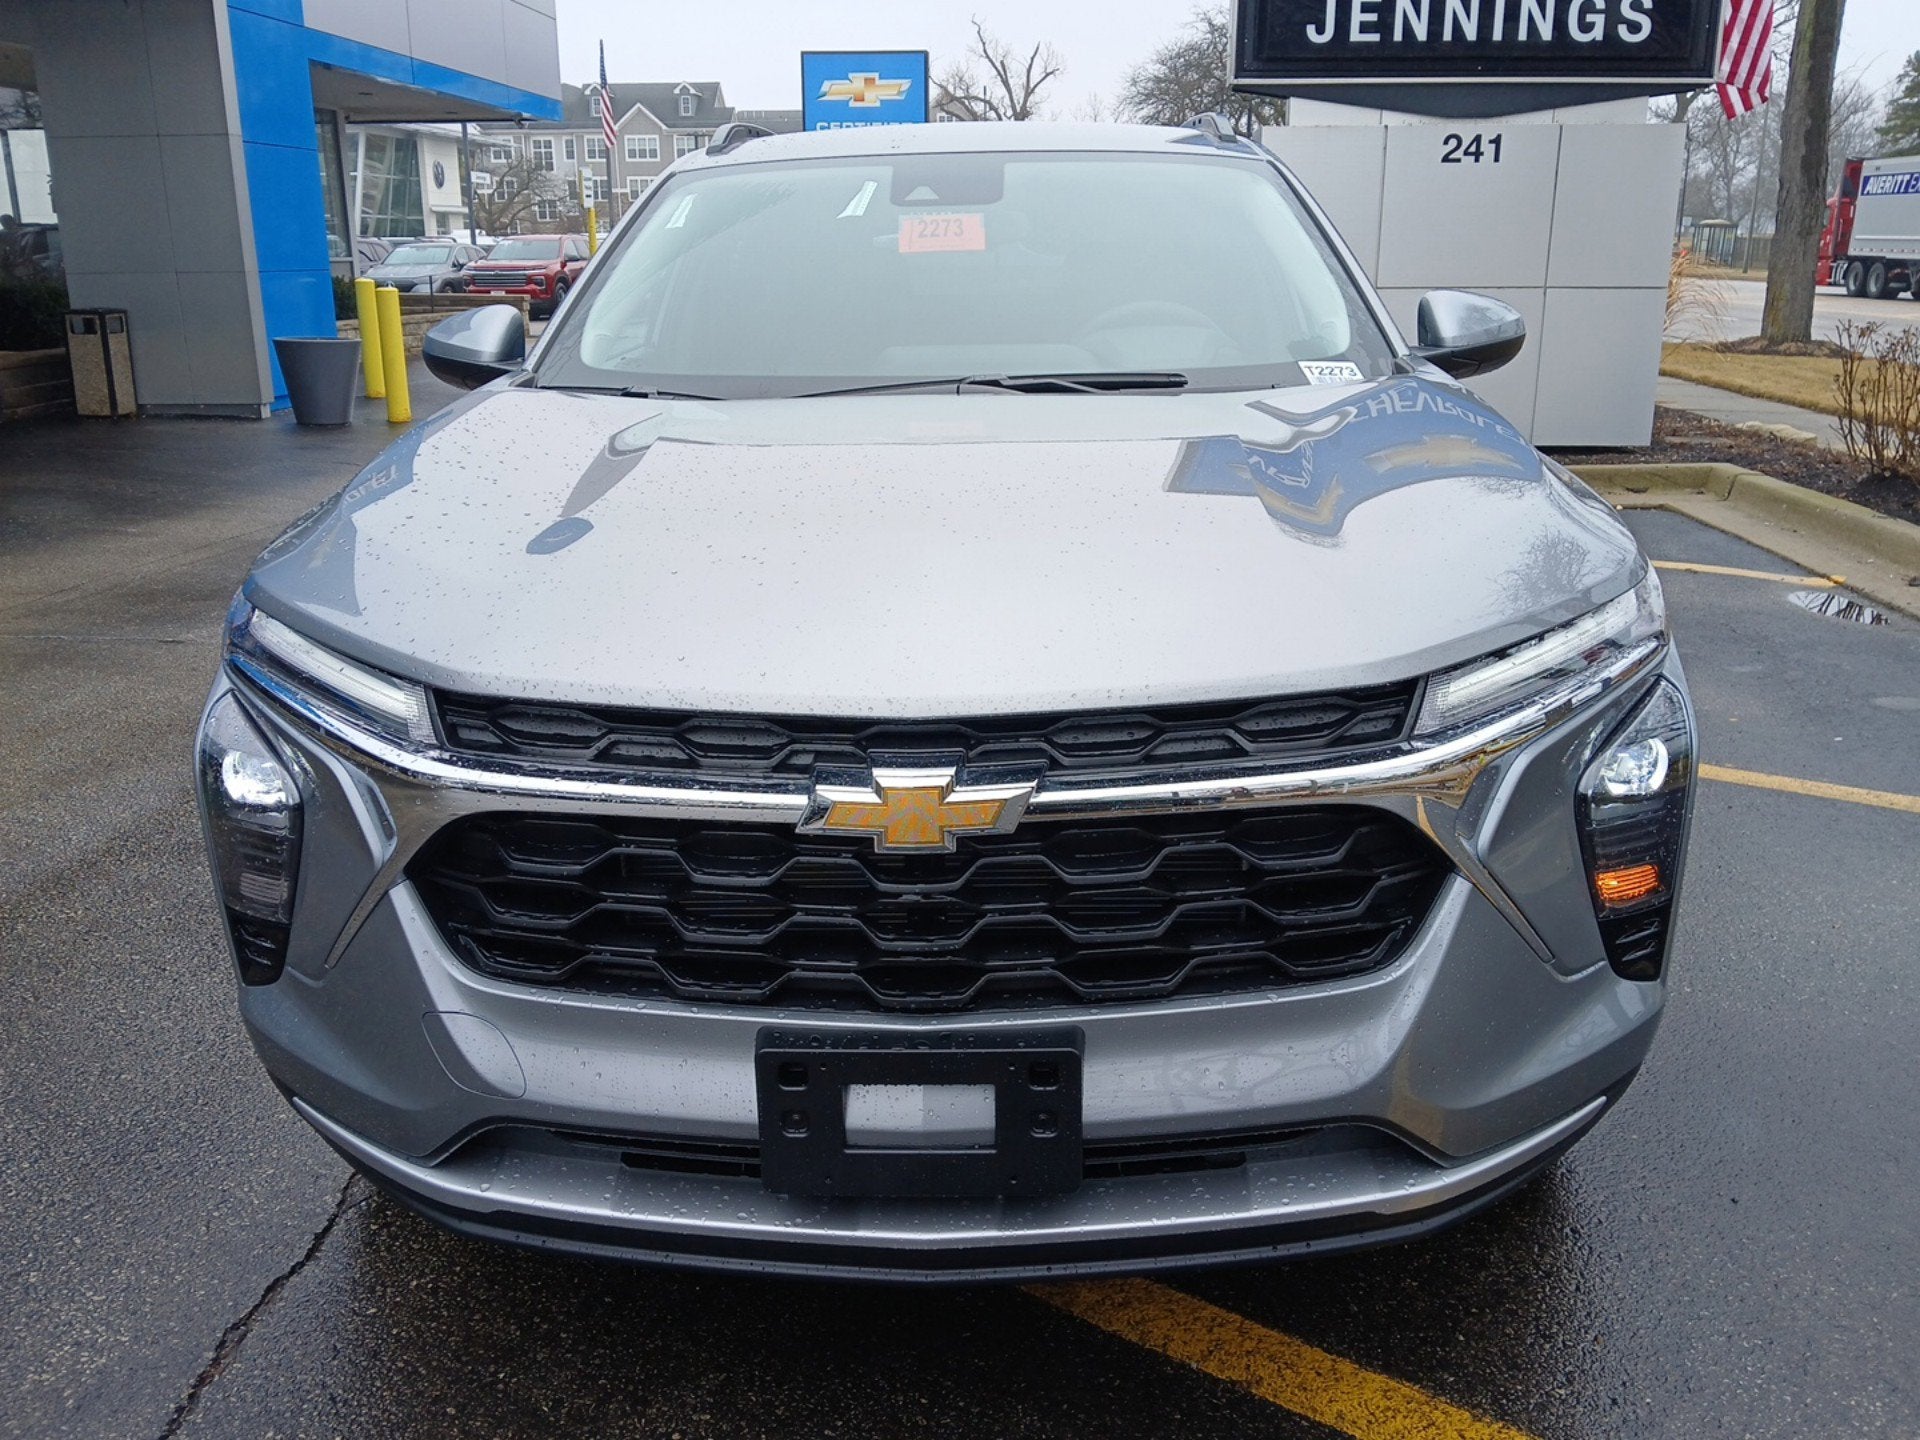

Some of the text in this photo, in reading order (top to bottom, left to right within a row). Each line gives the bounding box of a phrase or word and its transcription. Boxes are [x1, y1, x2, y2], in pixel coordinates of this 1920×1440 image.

[1306, 0, 1653, 44] JENNINGS
[1441, 133, 1502, 163] 241
[1863, 174, 1910, 195] AVERITT
[917, 218, 965, 239] 2273
[1304, 365, 1357, 377] T2273
